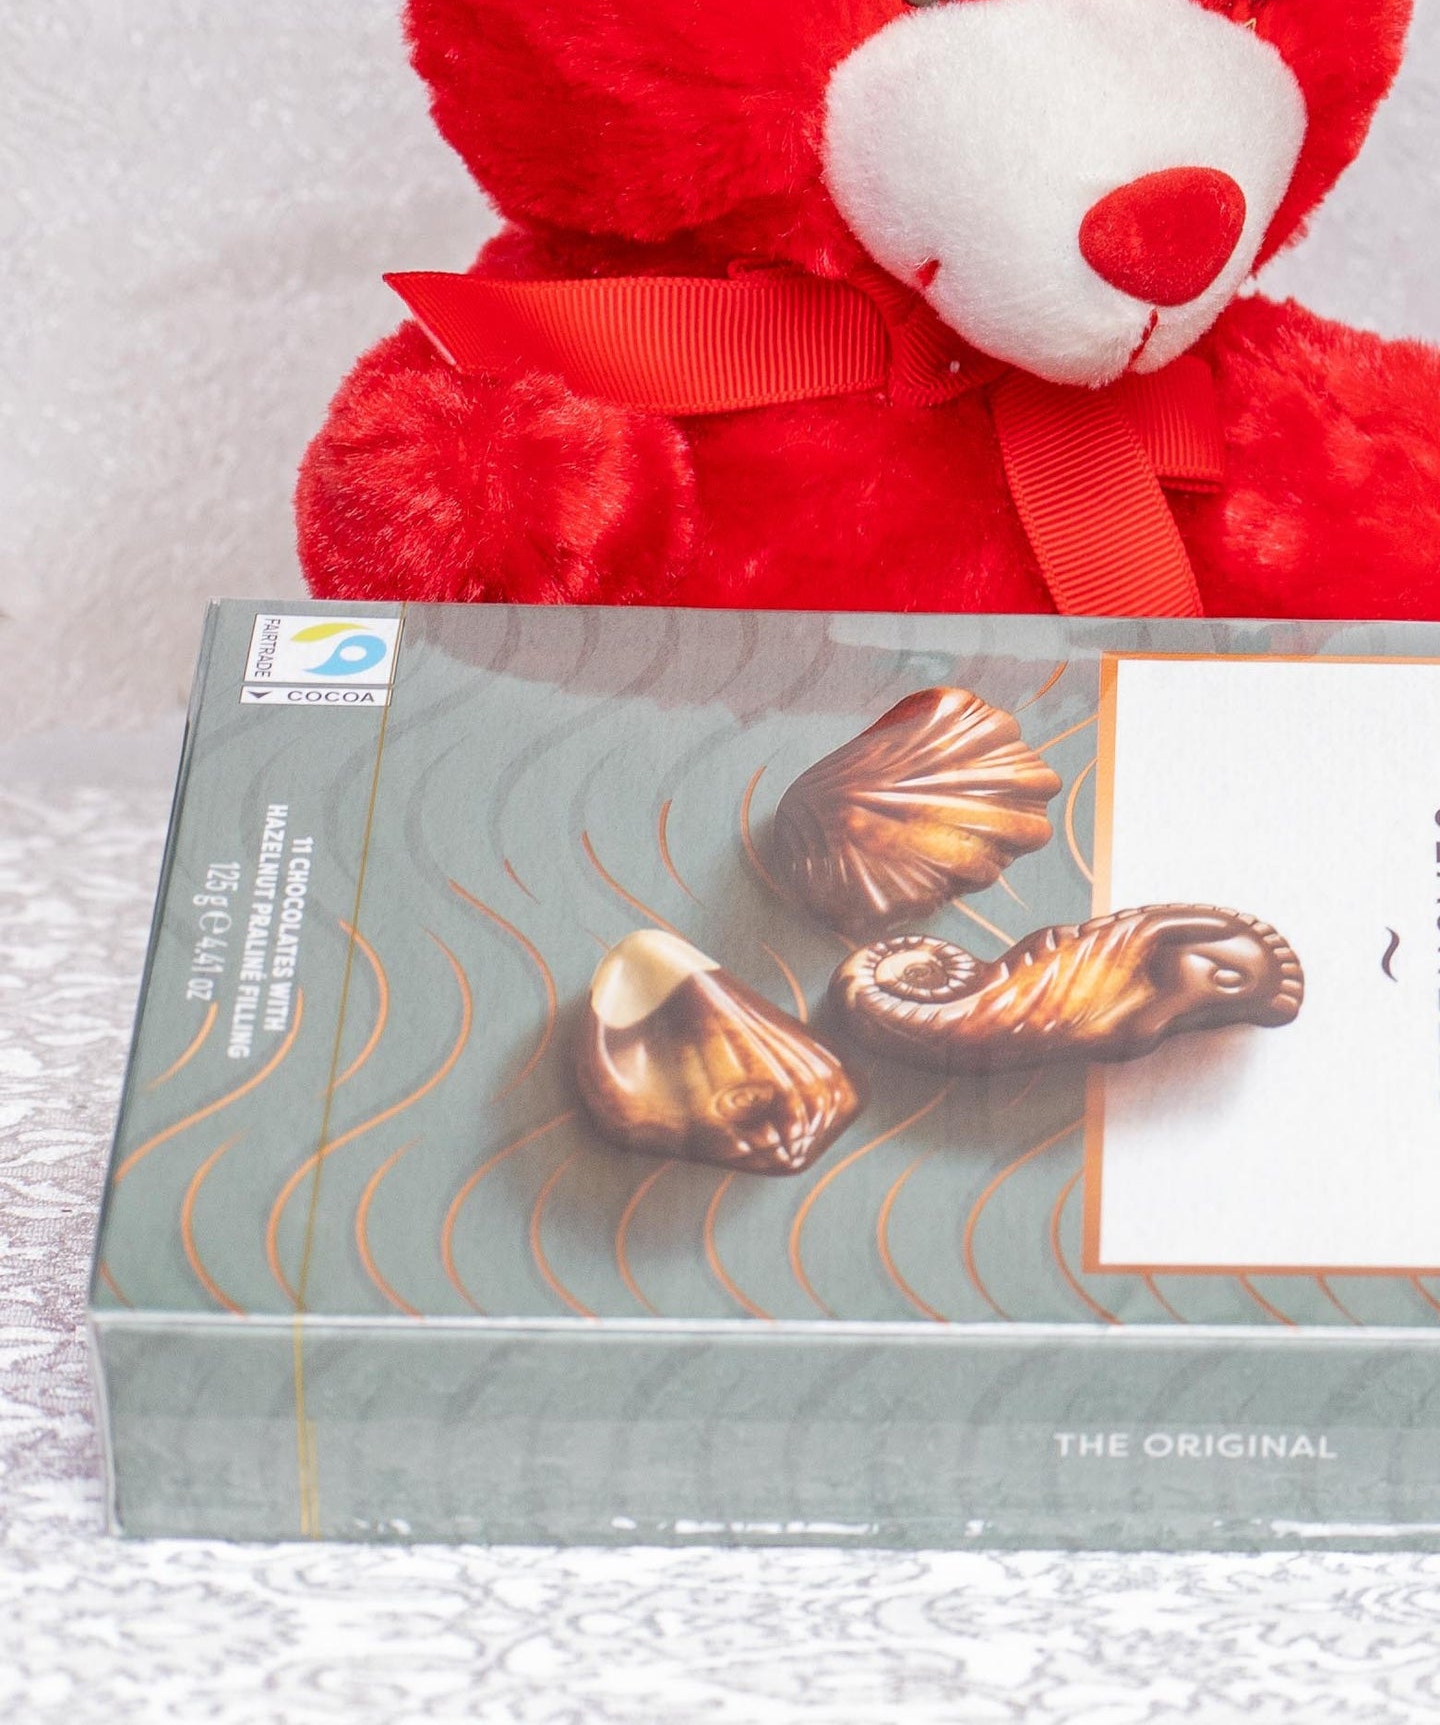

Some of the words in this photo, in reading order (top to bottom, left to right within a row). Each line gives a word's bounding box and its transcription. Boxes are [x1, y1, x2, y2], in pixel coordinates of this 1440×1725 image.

[254, 618, 281, 678] FAIRTRADE
[287, 690, 375, 703] COCOA
[254, 804, 289, 900] HAZELNUT
[291, 836, 314, 853] 11
[239, 902, 274, 982] PRALINÉ
[271, 857, 311, 978] CHOCOLATES
[191, 936, 228, 973] 4.41
[226, 984, 261, 1059] FILLING
[263, 982, 293, 1032] WITH
[1053, 1431, 1129, 1458] THE
[1142, 1431, 1339, 1459] ORIGINAL
